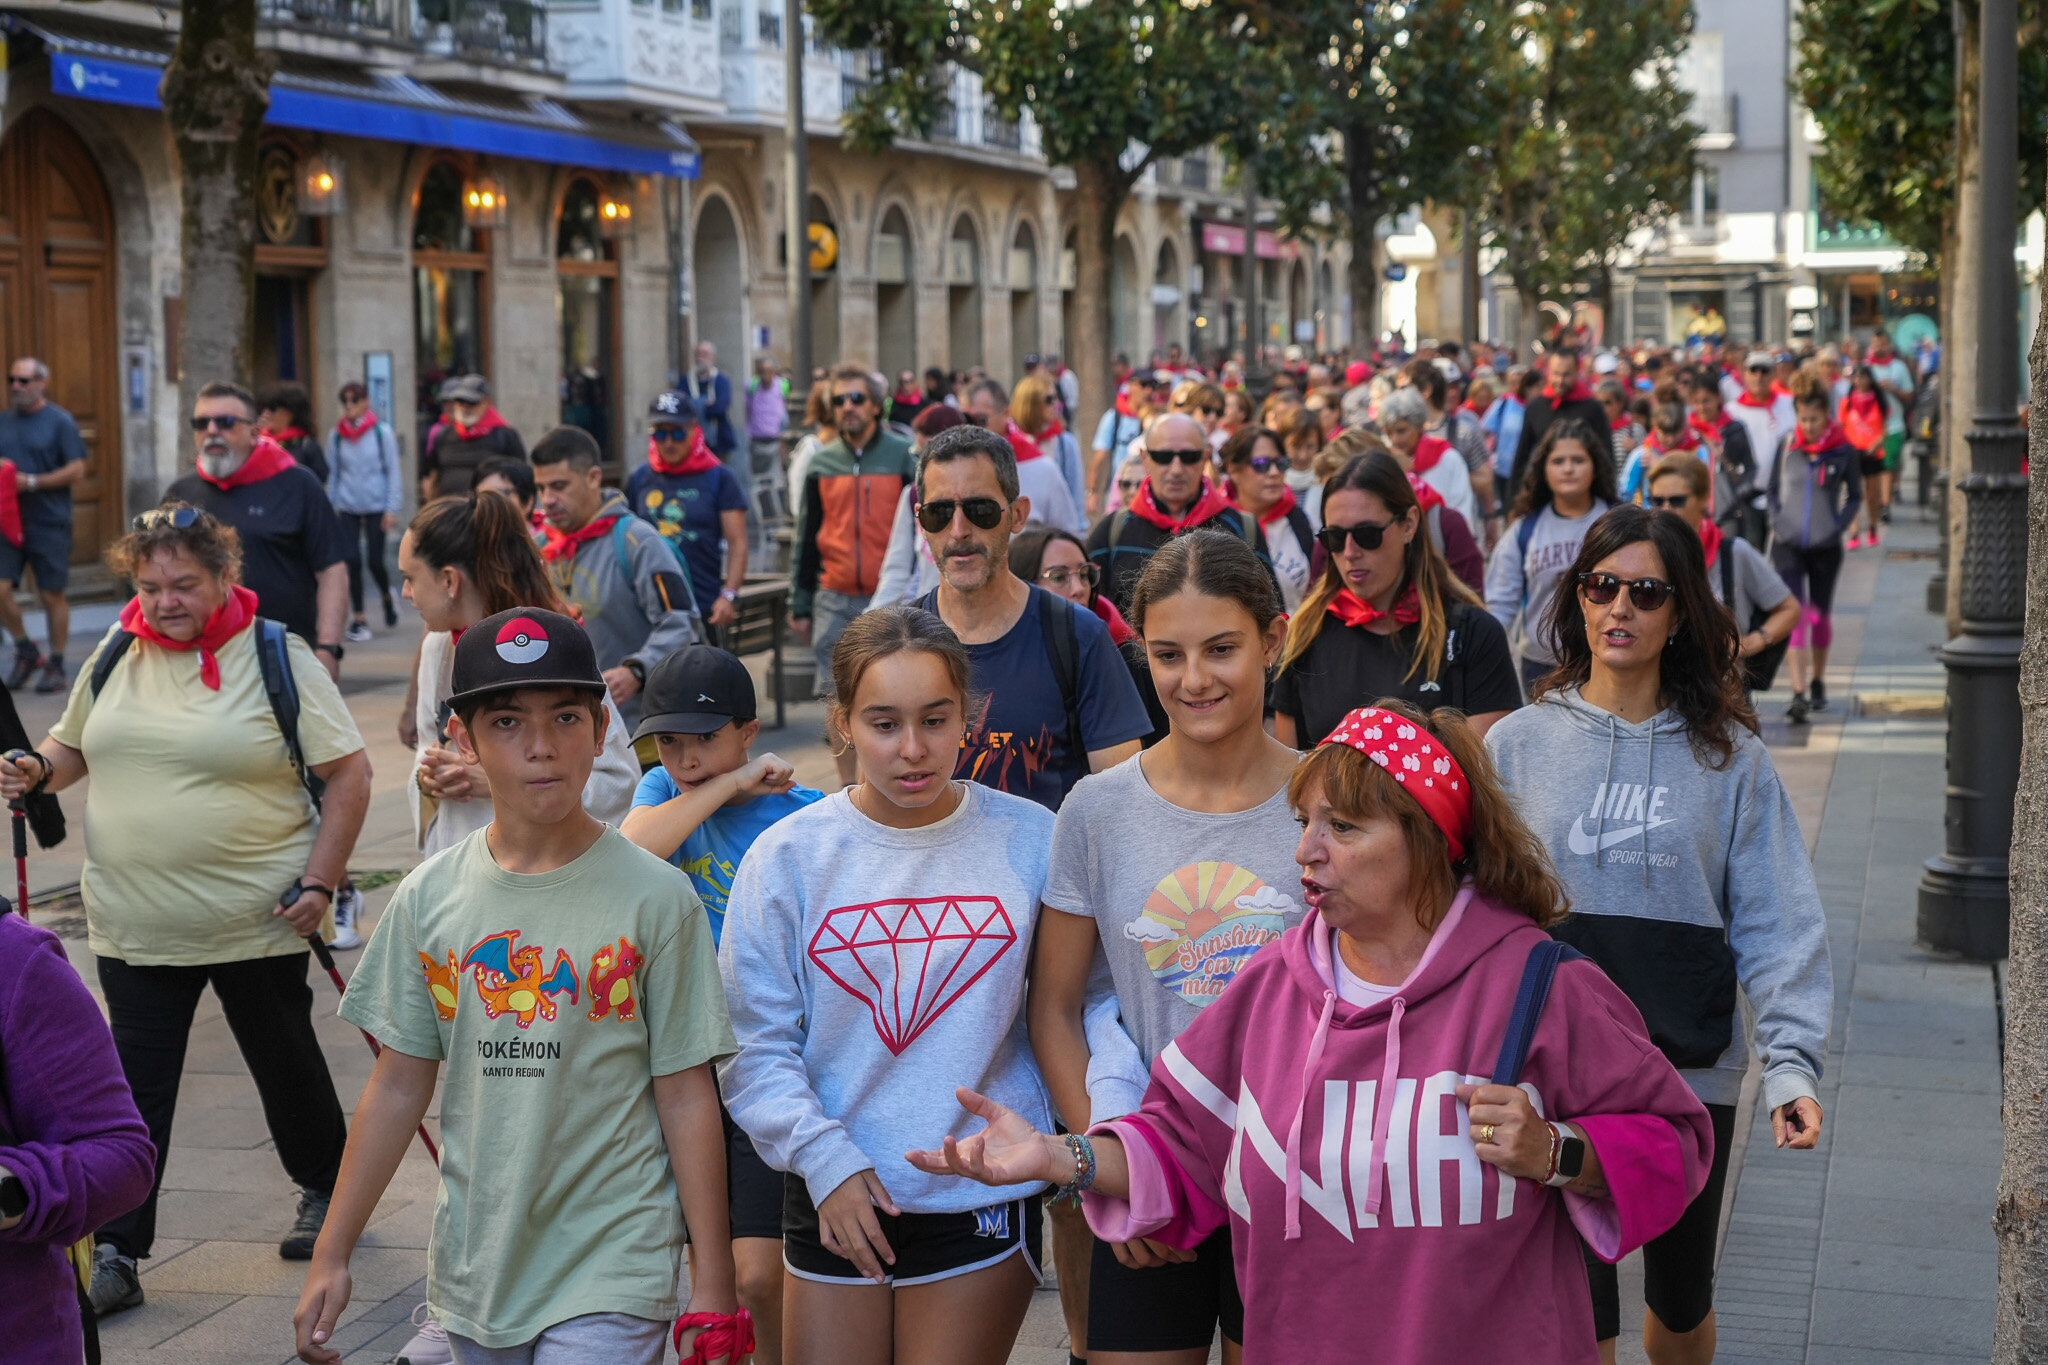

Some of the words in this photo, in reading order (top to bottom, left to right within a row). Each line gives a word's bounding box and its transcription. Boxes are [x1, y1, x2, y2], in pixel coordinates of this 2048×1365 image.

[1531, 541, 1584, 576] HARV
[1589, 782, 1669, 823] NIKE
[1203, 957, 1229, 976] on
[1181, 976, 1226, 996] min
[477, 1036, 561, 1059] POKÉMON
[483, 1067, 514, 1077] KANTO
[515, 1067, 545, 1078] REGION
[972, 1202, 1010, 1239] M
